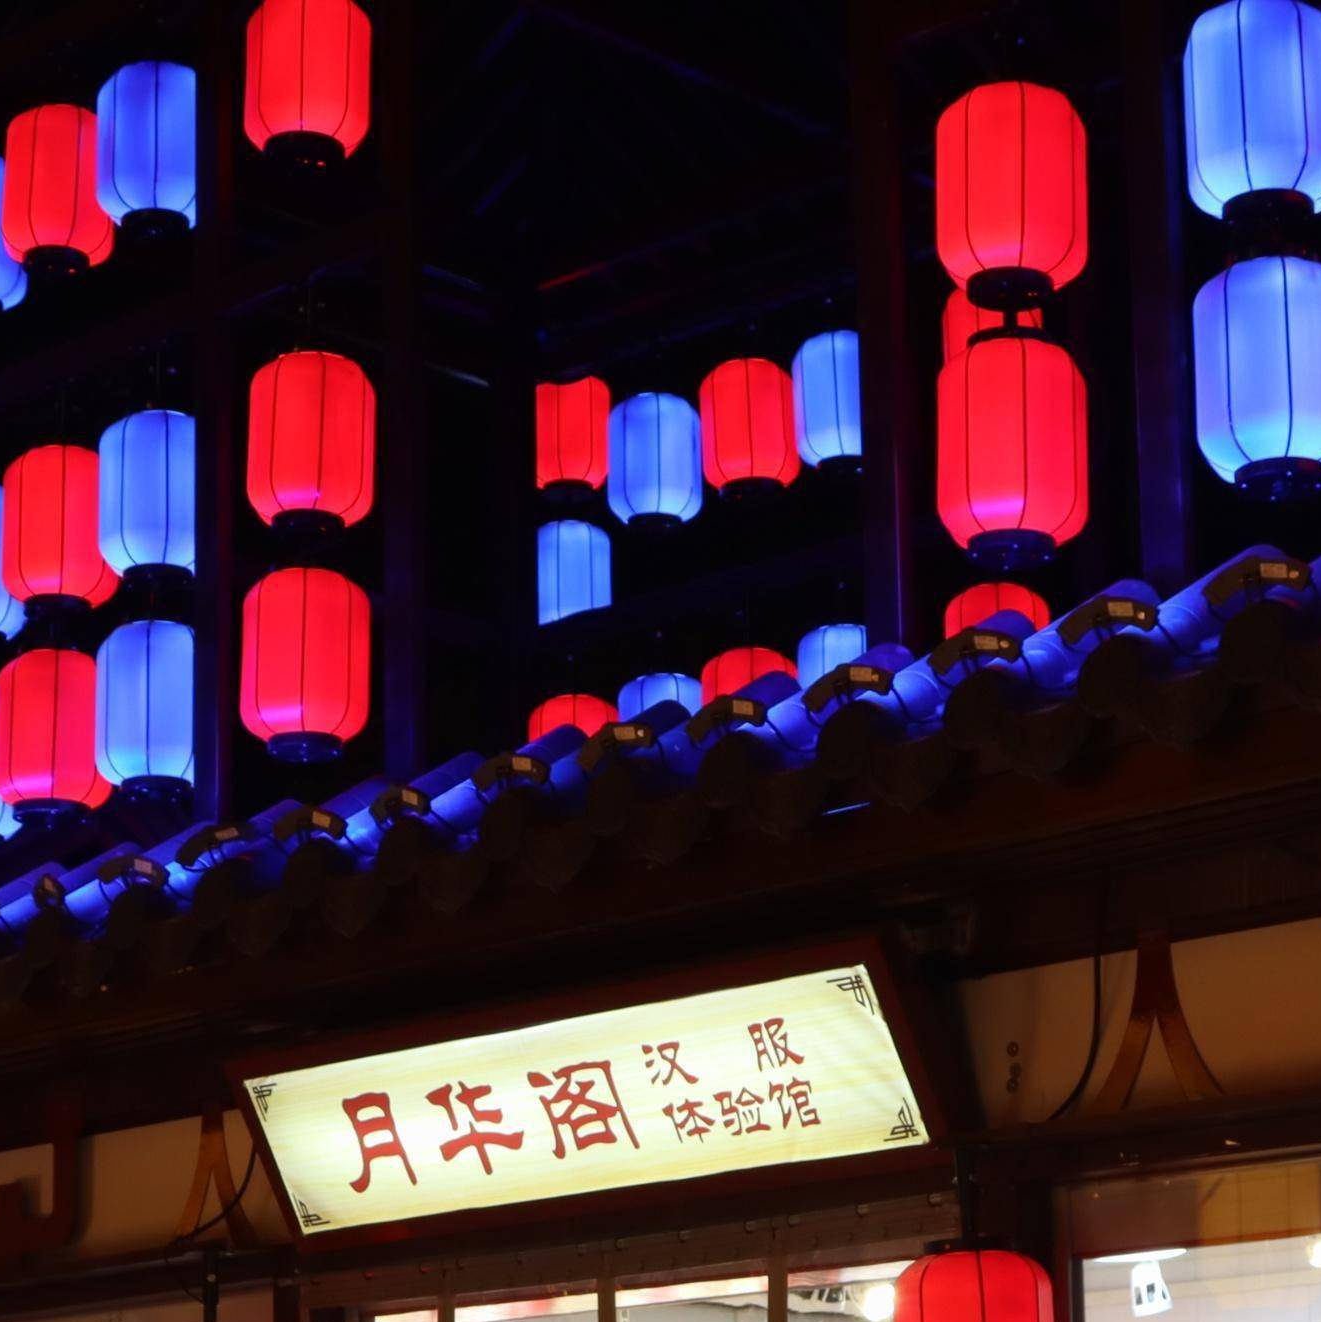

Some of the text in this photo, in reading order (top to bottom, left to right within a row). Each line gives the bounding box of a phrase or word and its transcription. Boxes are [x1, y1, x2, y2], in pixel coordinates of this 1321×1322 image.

[642, 1017, 805, 1087] 汉服
[341, 1060, 640, 1194] 月华阁
[663, 1076, 822, 1145] 体验馆
